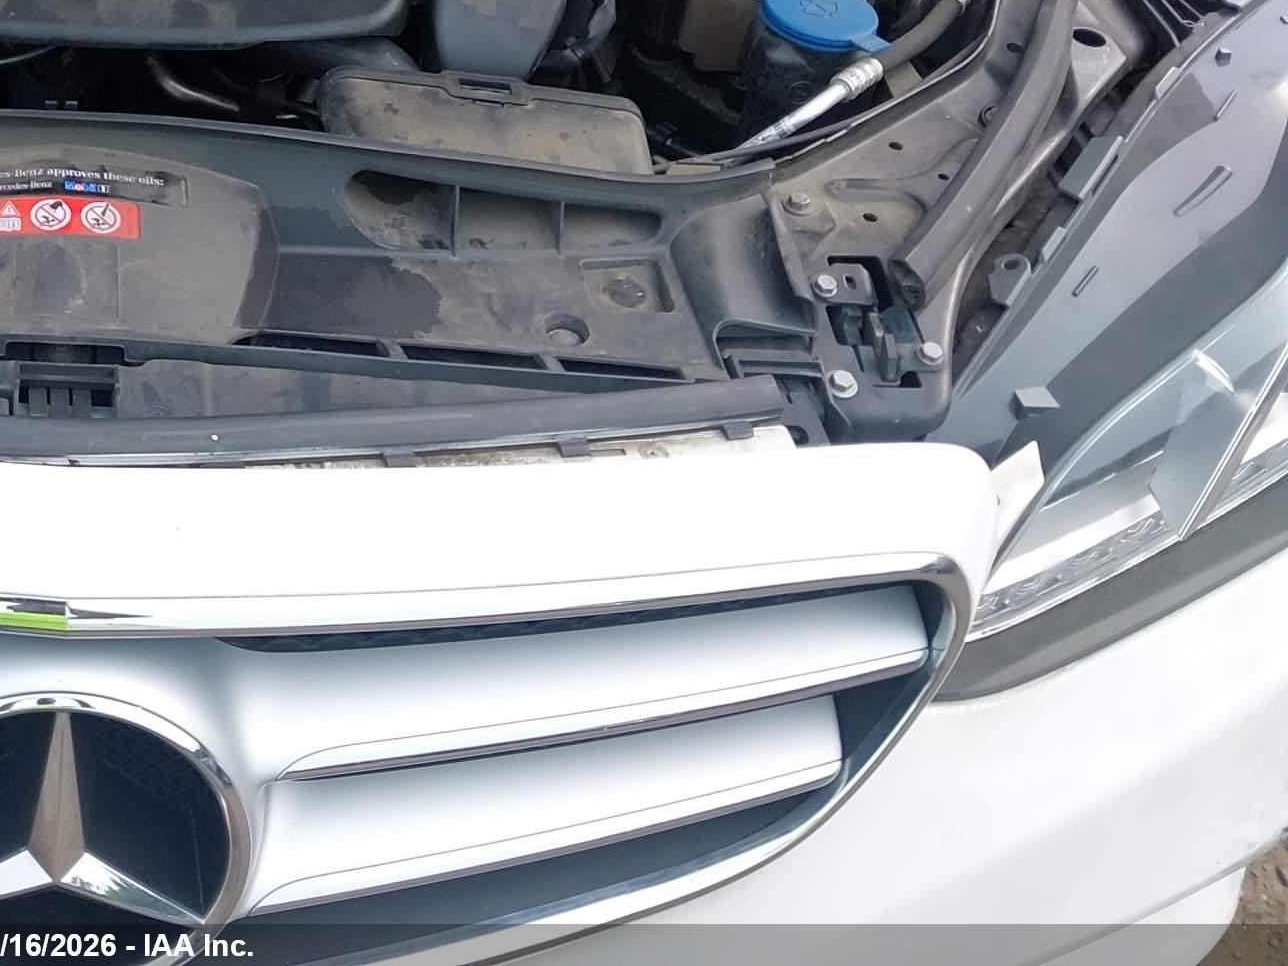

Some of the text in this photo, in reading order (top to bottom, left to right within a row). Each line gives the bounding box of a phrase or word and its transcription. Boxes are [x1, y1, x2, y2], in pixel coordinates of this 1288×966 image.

[46, 167, 101, 179] approves
[103, 171, 136, 183] these
[138, 175, 165, 187] oils:
